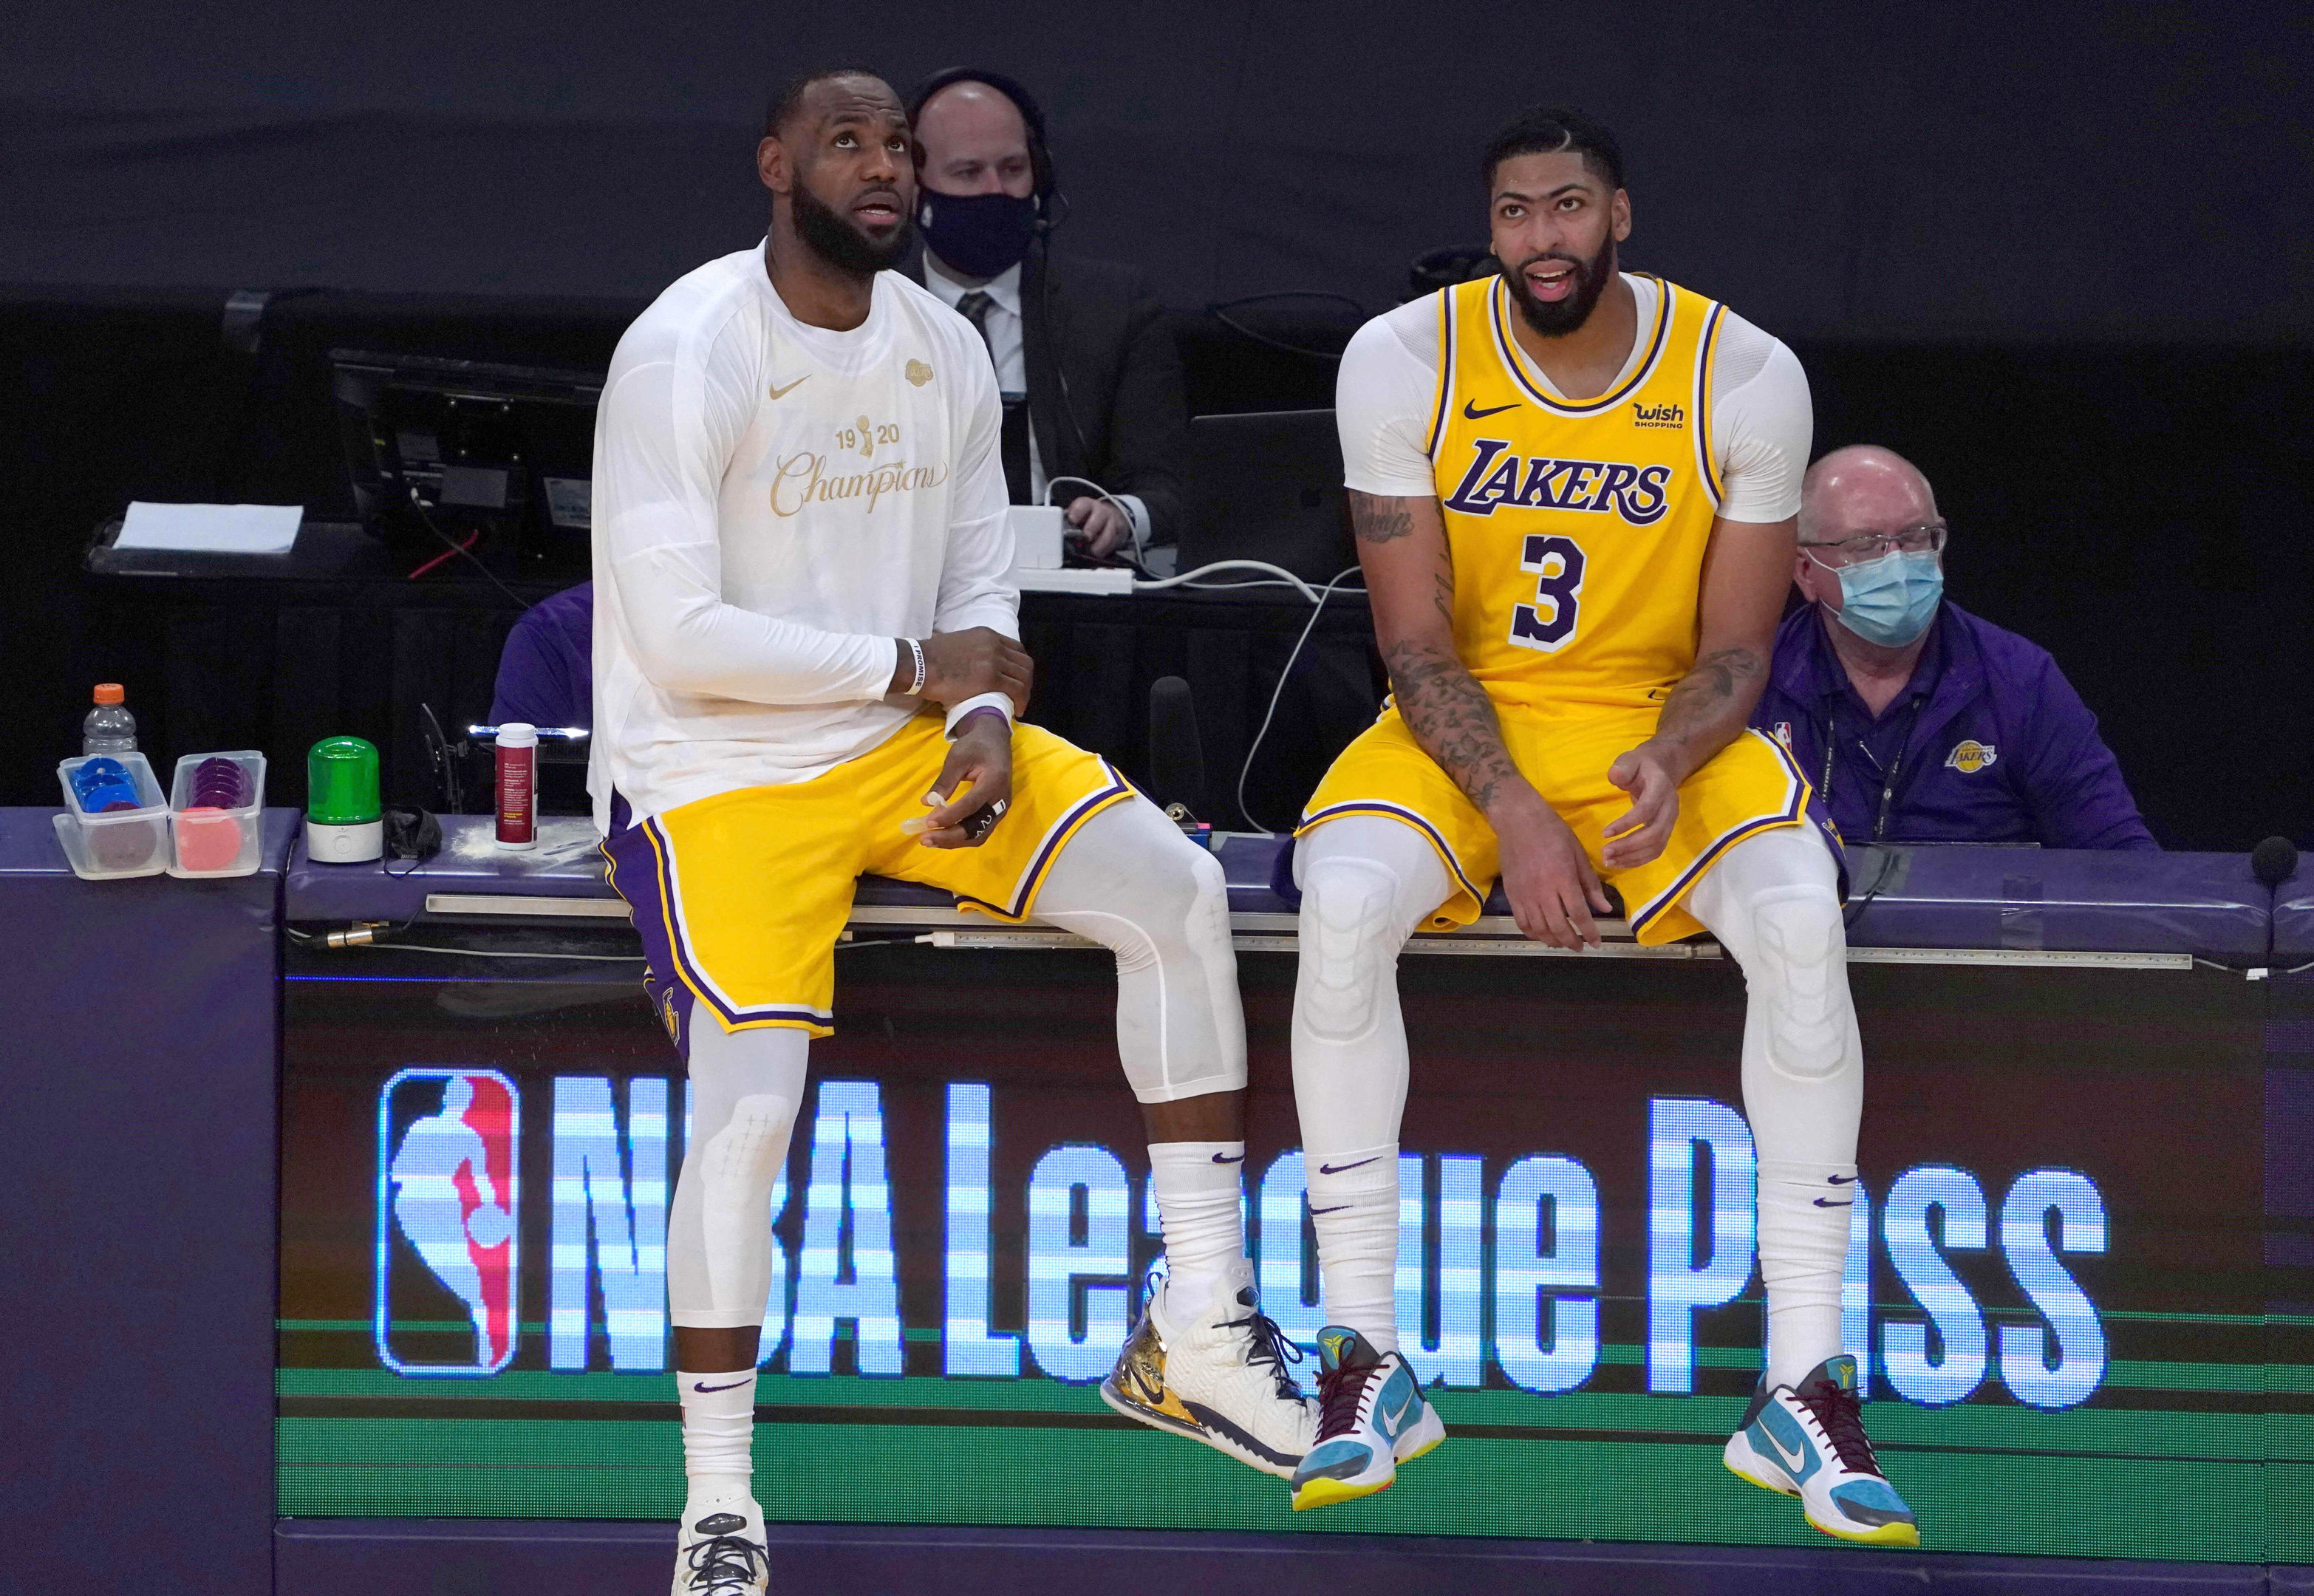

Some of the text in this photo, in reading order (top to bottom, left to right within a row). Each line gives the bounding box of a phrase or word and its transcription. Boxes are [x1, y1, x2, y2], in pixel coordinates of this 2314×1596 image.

[836, 423, 899, 449] 19 20
[1634, 403, 1684, 421] wish
[771, 451, 948, 517] Champions
[1444, 437, 1673, 527] LAKERS
[1508, 533, 1587, 653] 3
[915, 649, 924, 686] PROMISE
